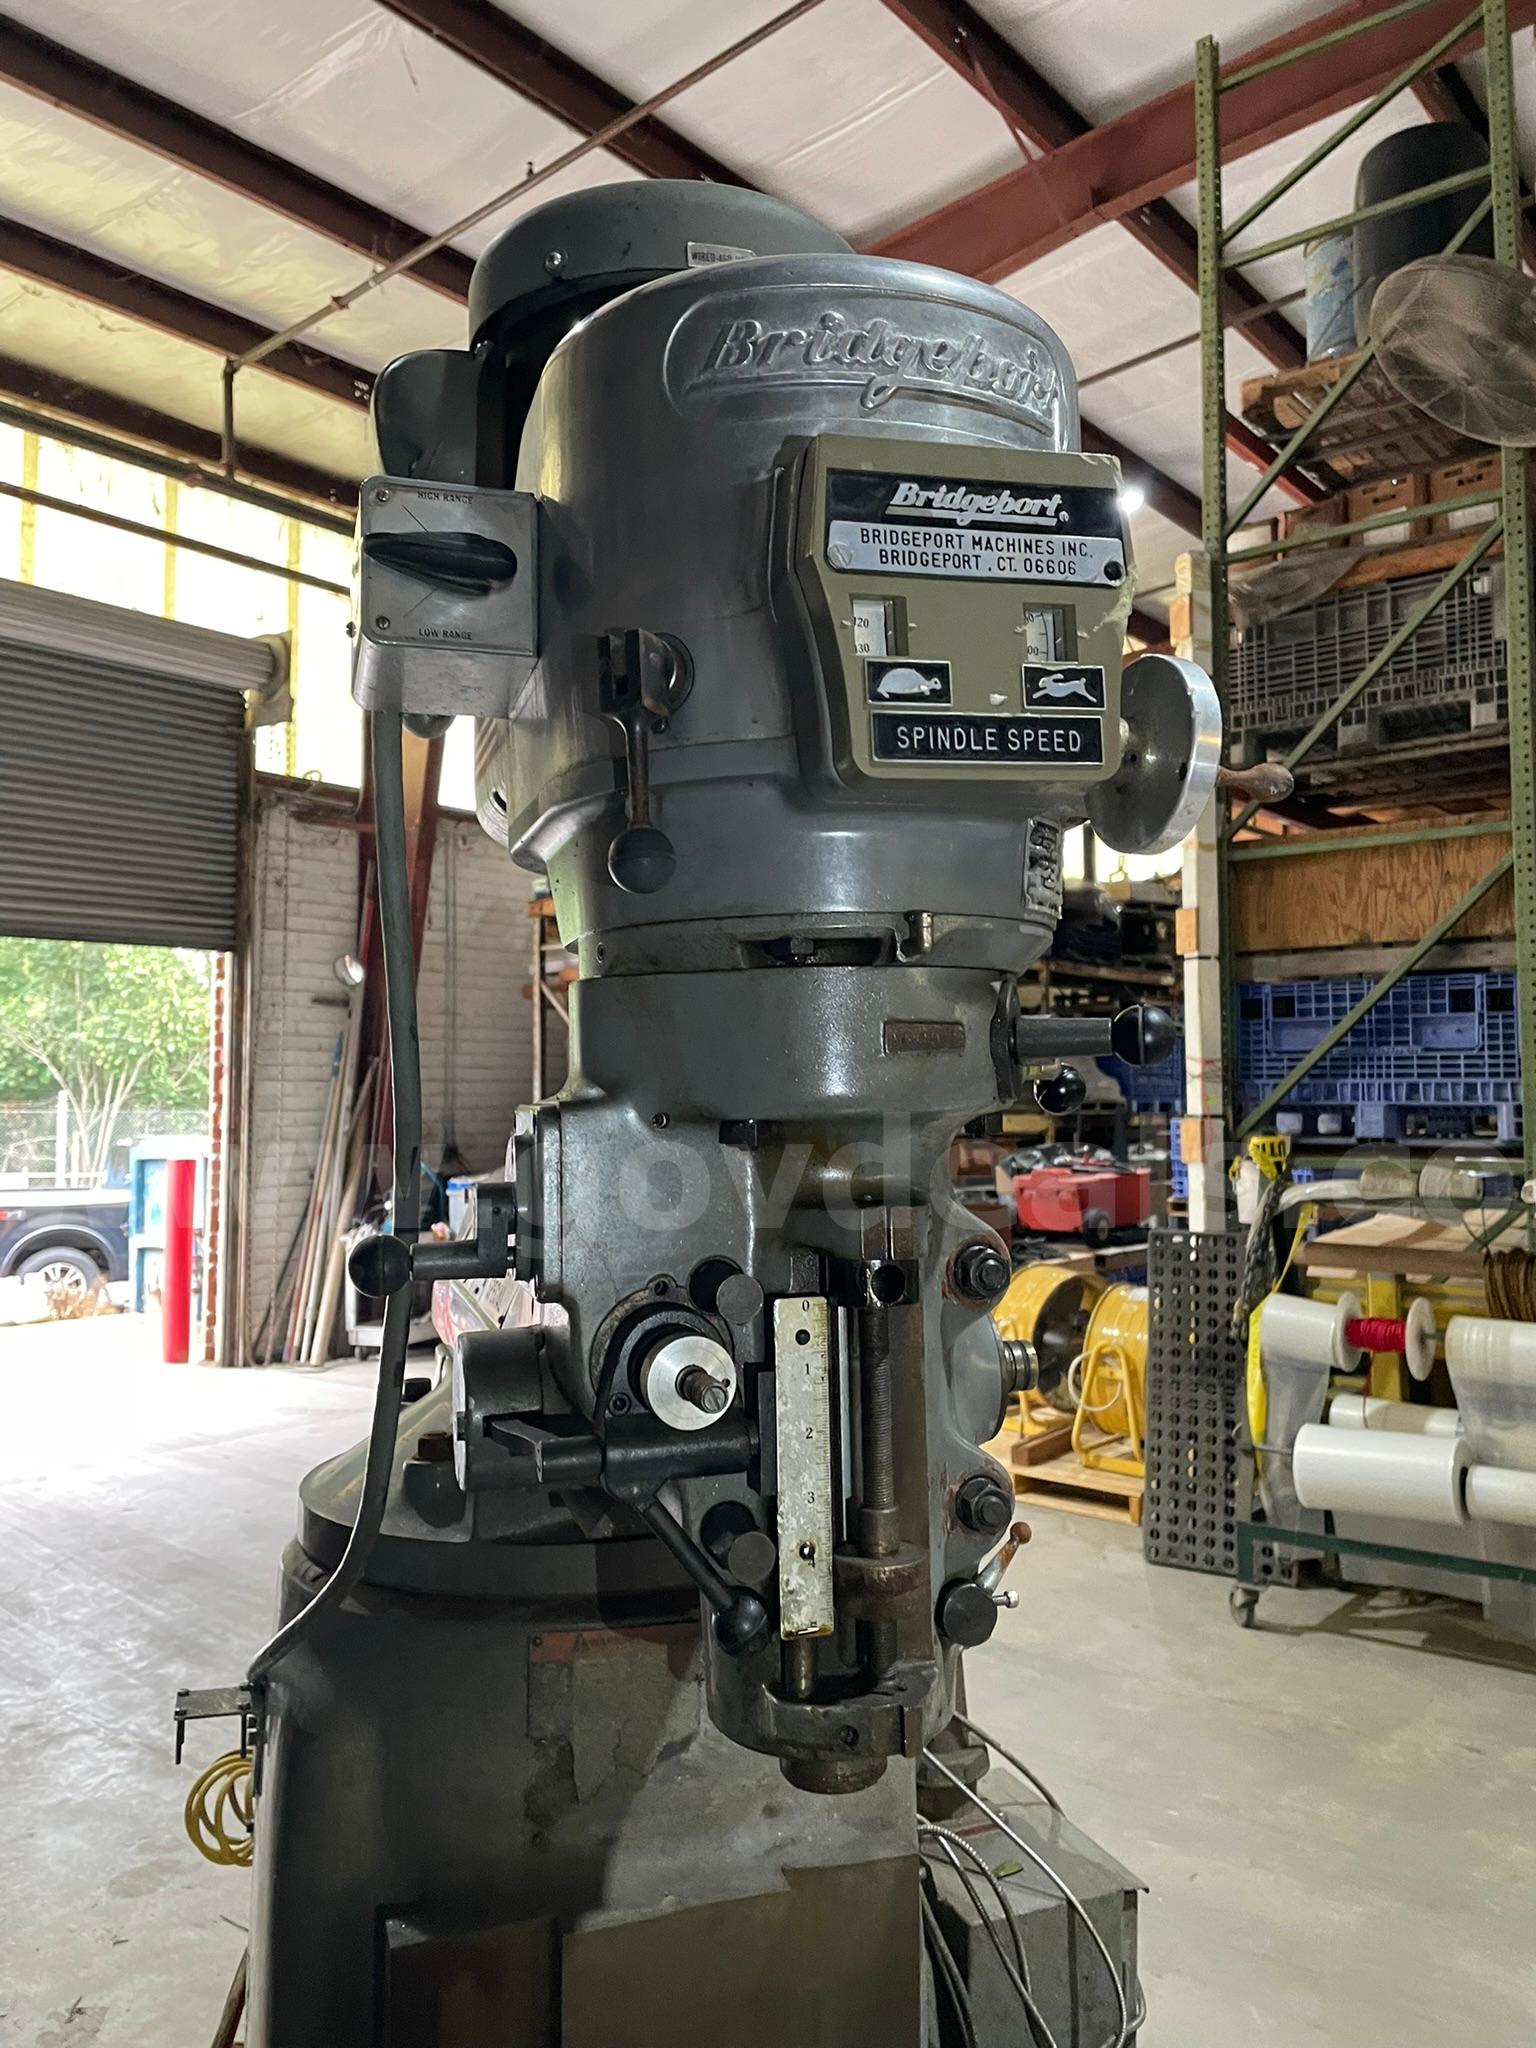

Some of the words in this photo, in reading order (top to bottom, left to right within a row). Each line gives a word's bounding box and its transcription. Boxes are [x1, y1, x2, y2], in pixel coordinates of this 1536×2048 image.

[704, 310, 1058, 410] Bridgeport
[417, 490, 440, 501] HIGH
[442, 493, 473, 505] RANGE
[888, 482, 1062, 526] Bridgeport
[860, 528, 965, 551] BRIDGEPORT
[972, 536, 1055, 556] MACHINES
[1062, 542, 1094, 559] INC.
[879, 549, 982, 571] BRIDGEPORT
[997, 556, 1017, 572] CT.
[1023, 558, 1077, 575] 06606
[418, 628, 439, 638] LOW
[442, 630, 473, 641] RANGE
[897, 726, 999, 751] SPINDLE
[1007, 728, 1081, 752] SPEED
[802, 1299, 810, 1312] 0
[805, 1363, 810, 1375] 1
[805, 1427, 813, 1440] 2
[807, 1491, 815, 1504] 3
